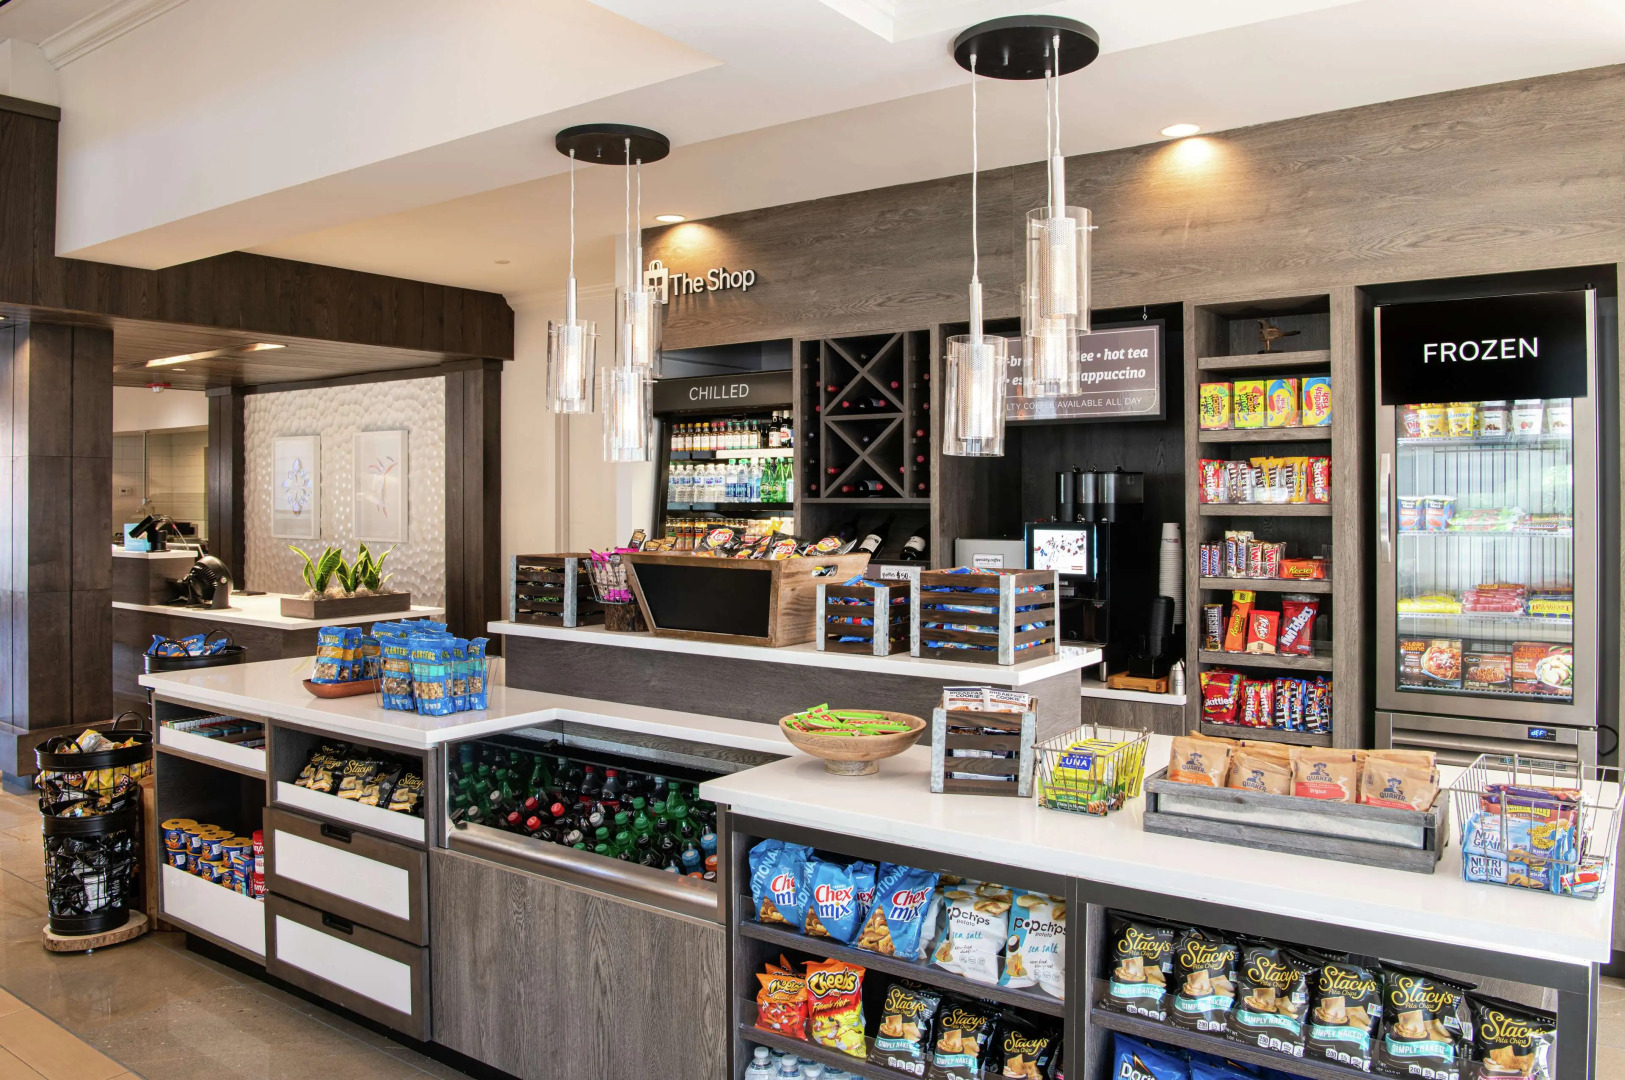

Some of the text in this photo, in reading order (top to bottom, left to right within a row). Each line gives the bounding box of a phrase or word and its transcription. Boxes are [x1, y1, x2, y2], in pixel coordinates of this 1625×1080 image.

[669, 266, 756, 296] The Shop
[1104, 349, 1125, 361] hot
[1127, 348, 1148, 358] tea
[1423, 337, 1538, 363] FROZEN
[689, 384, 749, 401] CHILLED
[1058, 399, 1102, 408] AVAILABLE
[1125, 397, 1142, 405] DAY
[1408, 421, 1420, 429] Dib
[1206, 466, 1214, 500] Skittles
[1313, 462, 1322, 499] Skittles
[1204, 697, 1233, 707] Skittles
[1246, 686, 1255, 721] Skittles
[343, 760, 373, 777] Stacy's
[1182, 765, 1205, 773] QUAKER
[1242, 780, 1267, 792] QUAKER
[1379, 792, 1407, 802] QUAKER
[1471, 857, 1501, 867] NUTRI
[1471, 867, 1502, 876] GRAIN
[776, 890, 797, 906] mi
[815, 885, 854, 903] Chex
[892, 887, 931, 906] Chex
[819, 902, 852, 919] mix
[889, 904, 921, 922] mix
[952, 930, 983, 939] sea salt
[1014, 917, 1066, 935] popchips
[1028, 943, 1059, 954] sea salt
[1118, 928, 1171, 959] Stacy's
[1180, 941, 1236, 971] Stacy's
[1205, 962, 1219, 970] Chips
[1248, 956, 1300, 990] Stacy's
[1114, 986, 1135, 994] SIMPLY
[1319, 966, 1377, 999] Stacy's
[885, 988, 926, 1018] Stacy's
[1391, 977, 1454, 1012] Stacy's
[942, 1008, 987, 1032] Stacy's
[1244, 1015, 1293, 1029] SIMPLY NAKED
[1312, 1028, 1362, 1040] SIMPLY NAKED
[1481, 1011, 1547, 1047] Stacy's
[878, 1040, 895, 1048] SIMPLY
[1004, 1030, 1049, 1056] Stacy's
[1509, 1036, 1526, 1044] Chips
[1391, 1044, 1445, 1054] SIMPLY NAKED
[936, 1056, 954, 1067] SIMPLY
